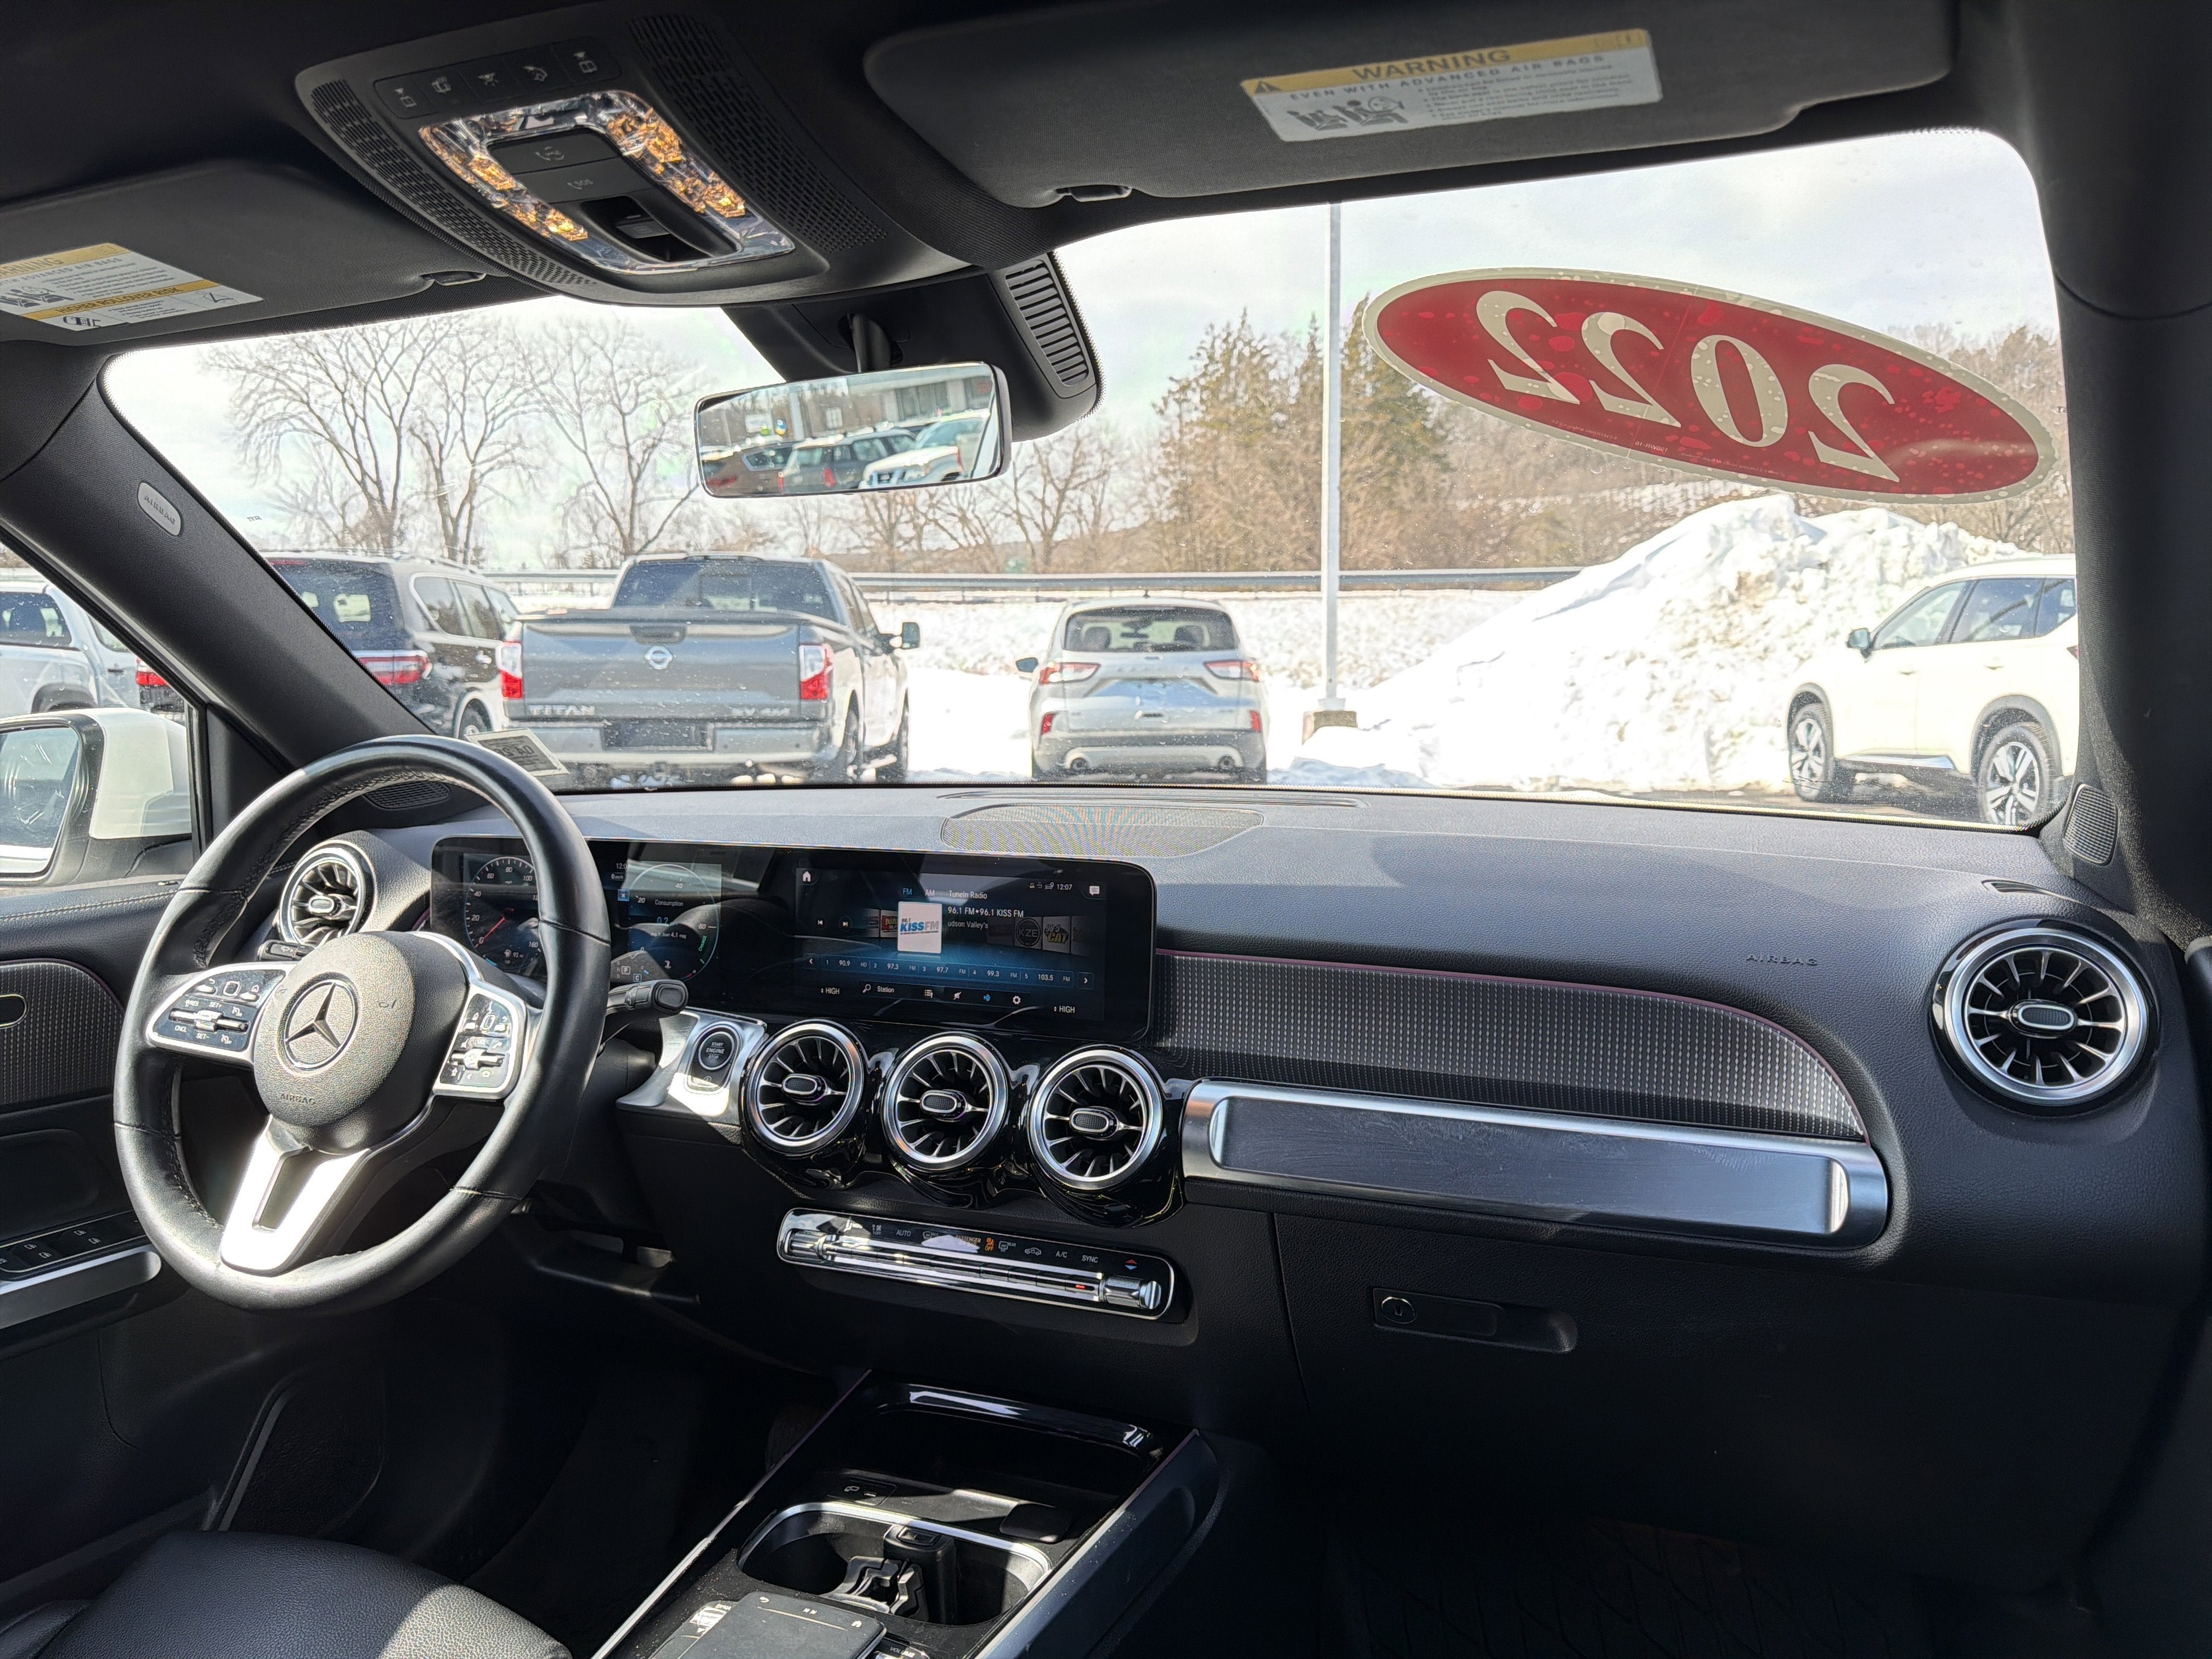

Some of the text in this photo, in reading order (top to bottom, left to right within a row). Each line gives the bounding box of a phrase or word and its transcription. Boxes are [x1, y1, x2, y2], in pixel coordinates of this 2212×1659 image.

[1351, 49, 1512, 81] WARNING
[1290, 54, 1605, 100] EVEN WITH ADVANCED AIR BAGS
[0, 256, 64, 276] ARNING
[94, 257, 122, 266] BAGS
[55, 286, 184, 314] HIGHER ROLLOVER RISK
[144, 495, 176, 525] AIRBAG
[528, 704, 595, 716] TITAN
[949, 890, 969, 898] TuneIn
[654, 899, 684, 907] Consumption
[947, 906, 962, 915] 96.1
[996, 909, 1012, 917] KISS
[1013, 910, 1024, 918] FM
[1019, 929, 1038, 938] KZE
[1047, 933, 1067, 943] CAT
[1746, 954, 1818, 966] AIRBAG
[280, 1093, 316, 1105] AIRBAG
[956, 1235, 981, 1244] PASSENGER
[1082, 1255, 1098, 1263] SYNC
[890, 1646, 916, 1658] VOLUME
